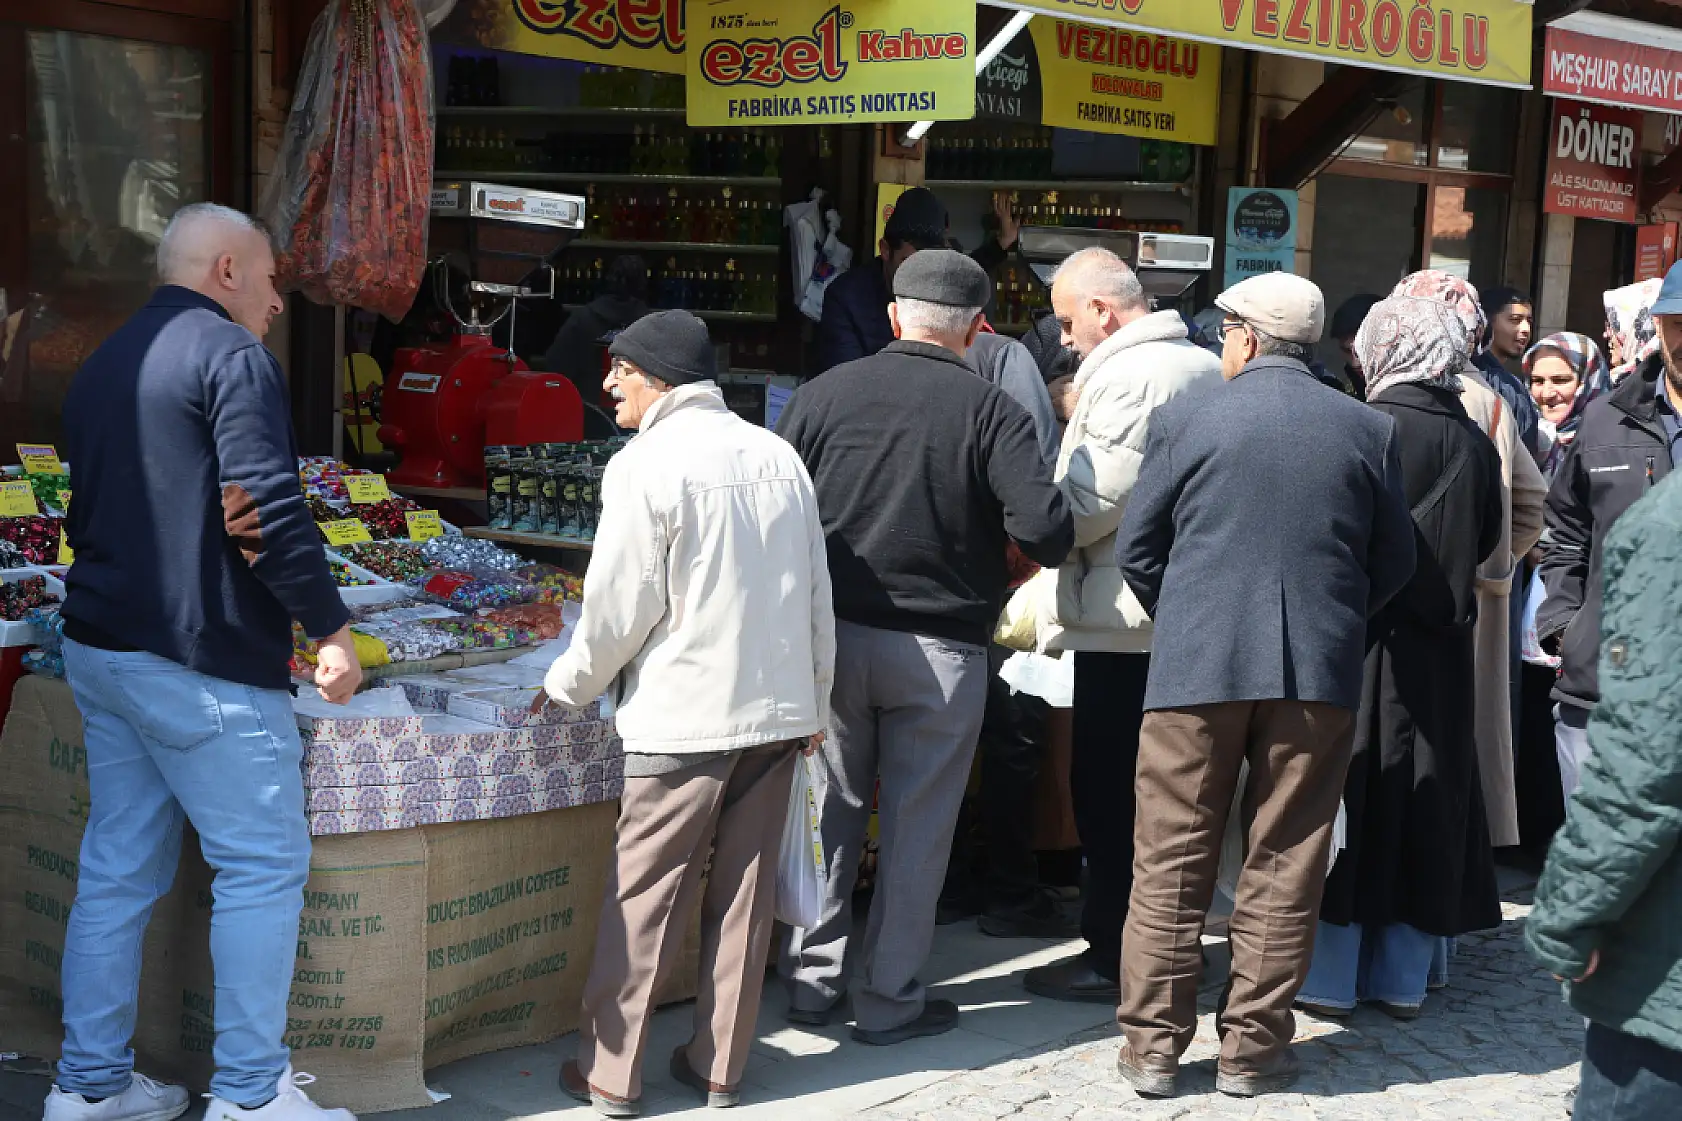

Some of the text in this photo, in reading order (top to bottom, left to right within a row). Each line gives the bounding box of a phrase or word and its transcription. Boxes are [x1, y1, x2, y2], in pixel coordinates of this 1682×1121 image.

[700, 5, 848, 88] ezel
[857, 28, 967, 63] Kahve
[1055, 21, 1200, 79] VEZİROĞLU
[1091, 73, 1163, 101] KOLONYALARI
[1550, 50, 1619, 94] MEŞHUR
[1622, 61, 1672, 99] SARAY
[728, 91, 936, 119] FABRİKA SATIŞ NOKTASI
[1077, 102, 1122, 125] FABRİKA
[1153, 111, 1176, 132] YERİ
[1556, 107, 1635, 169] DÖNER
[1557, 191, 1577, 208] ÜST
[1235, 257, 1283, 272] FABRİKA
[525, 865, 571, 896] COFFEE
[341, 917, 361, 937] VE
[316, 1017, 343, 1031] 134
[345, 1015, 384, 1032] 2756
[306, 1033, 335, 1048] 238
[339, 1033, 376, 1050] 1819
